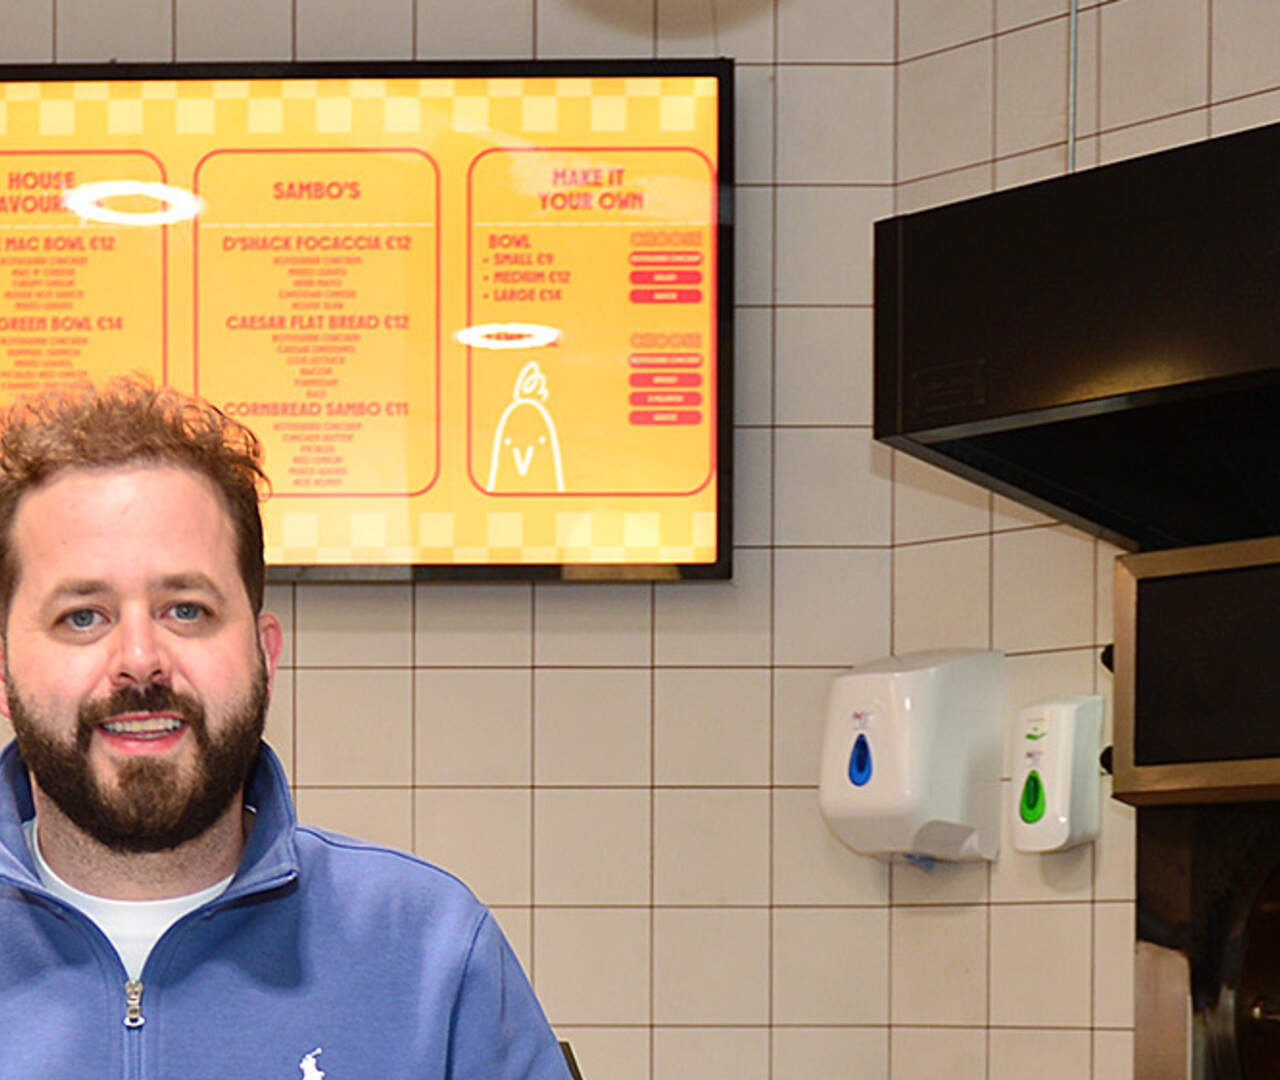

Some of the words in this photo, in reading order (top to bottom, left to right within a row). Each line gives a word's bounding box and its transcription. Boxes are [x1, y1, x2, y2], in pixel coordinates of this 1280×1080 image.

[7, 171, 76, 190] HOUSE
[552, 168, 603, 187] MAKE
[608, 168, 625, 186] IT
[273, 181, 361, 200] SAMBO'S
[538, 192, 593, 210] YOUR
[598, 192, 644, 210] OWN
[5, 237, 38, 251] MAC
[43, 237, 85, 251] BOWL
[89, 237, 116, 251] €12
[222, 236, 292, 251] D'SHACK
[296, 236, 381, 250] FOCACCIA
[386, 236, 412, 250] €12
[488, 234, 531, 249] BOWL
[493, 253, 533, 265] SMALL
[493, 271, 545, 283] MEDIUM
[493, 289, 535, 301] LARGE
[51, 317, 93, 331] BOWL
[226, 315, 286, 330] CAESAR
[291, 315, 325, 330] FLAT
[329, 315, 380, 330] BREAD
[384, 315, 410, 329] €12
[224, 402, 322, 417] CORNBREAD
[325, 402, 381, 416] SAMBO
[385, 402, 409, 416] €11
